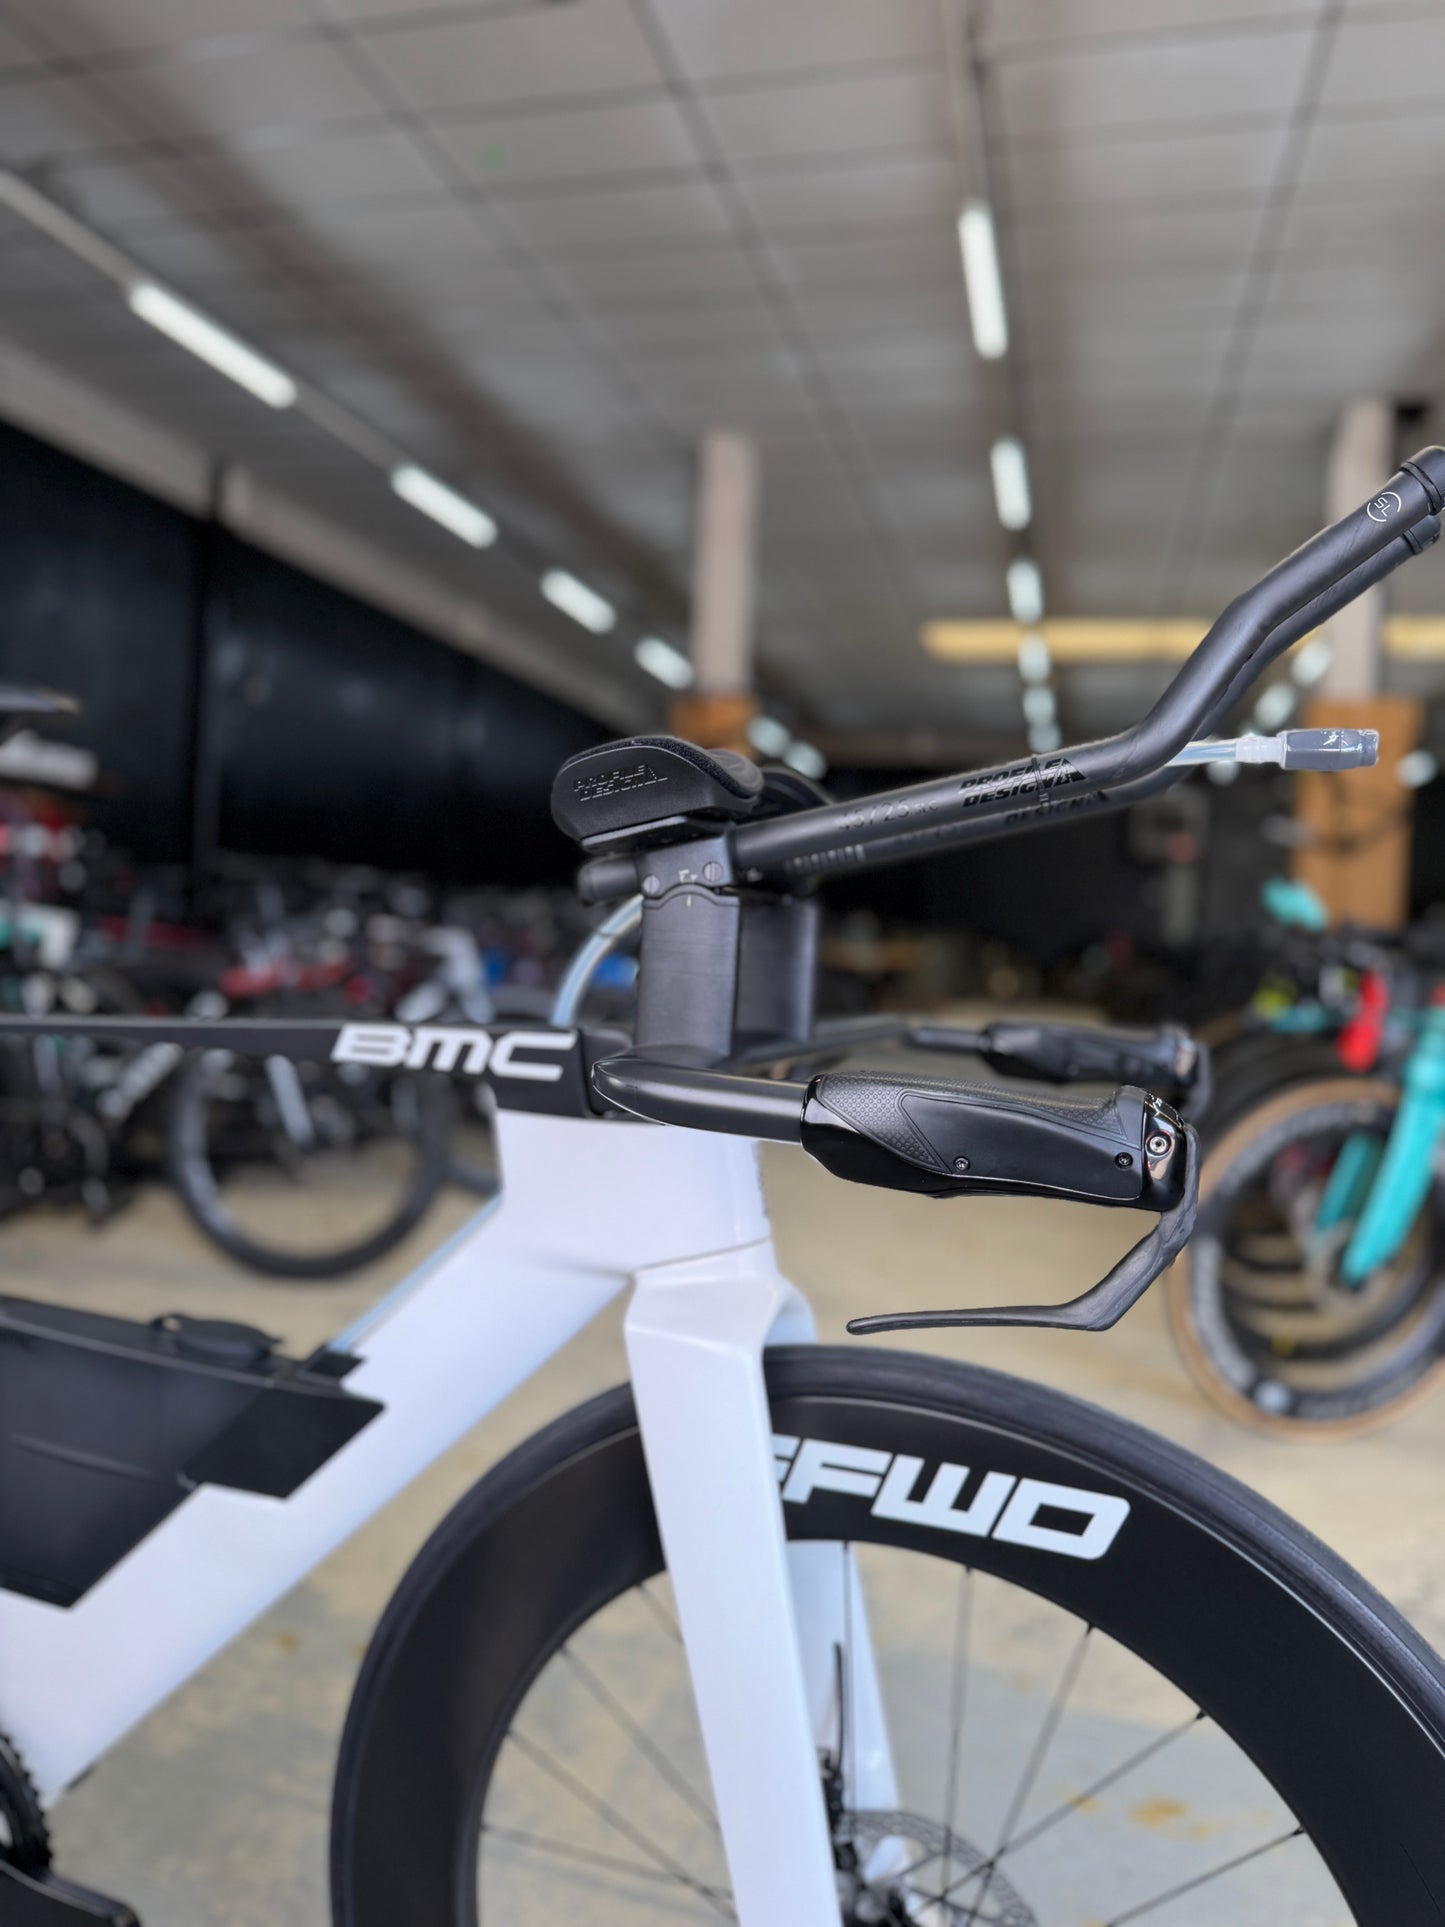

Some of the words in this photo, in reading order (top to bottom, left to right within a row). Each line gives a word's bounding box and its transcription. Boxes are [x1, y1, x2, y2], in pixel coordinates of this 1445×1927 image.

[1373, 497, 1391, 517] SL
[963, 772, 1057, 808] DESIGN
[331, 1023, 578, 1082] BMC
